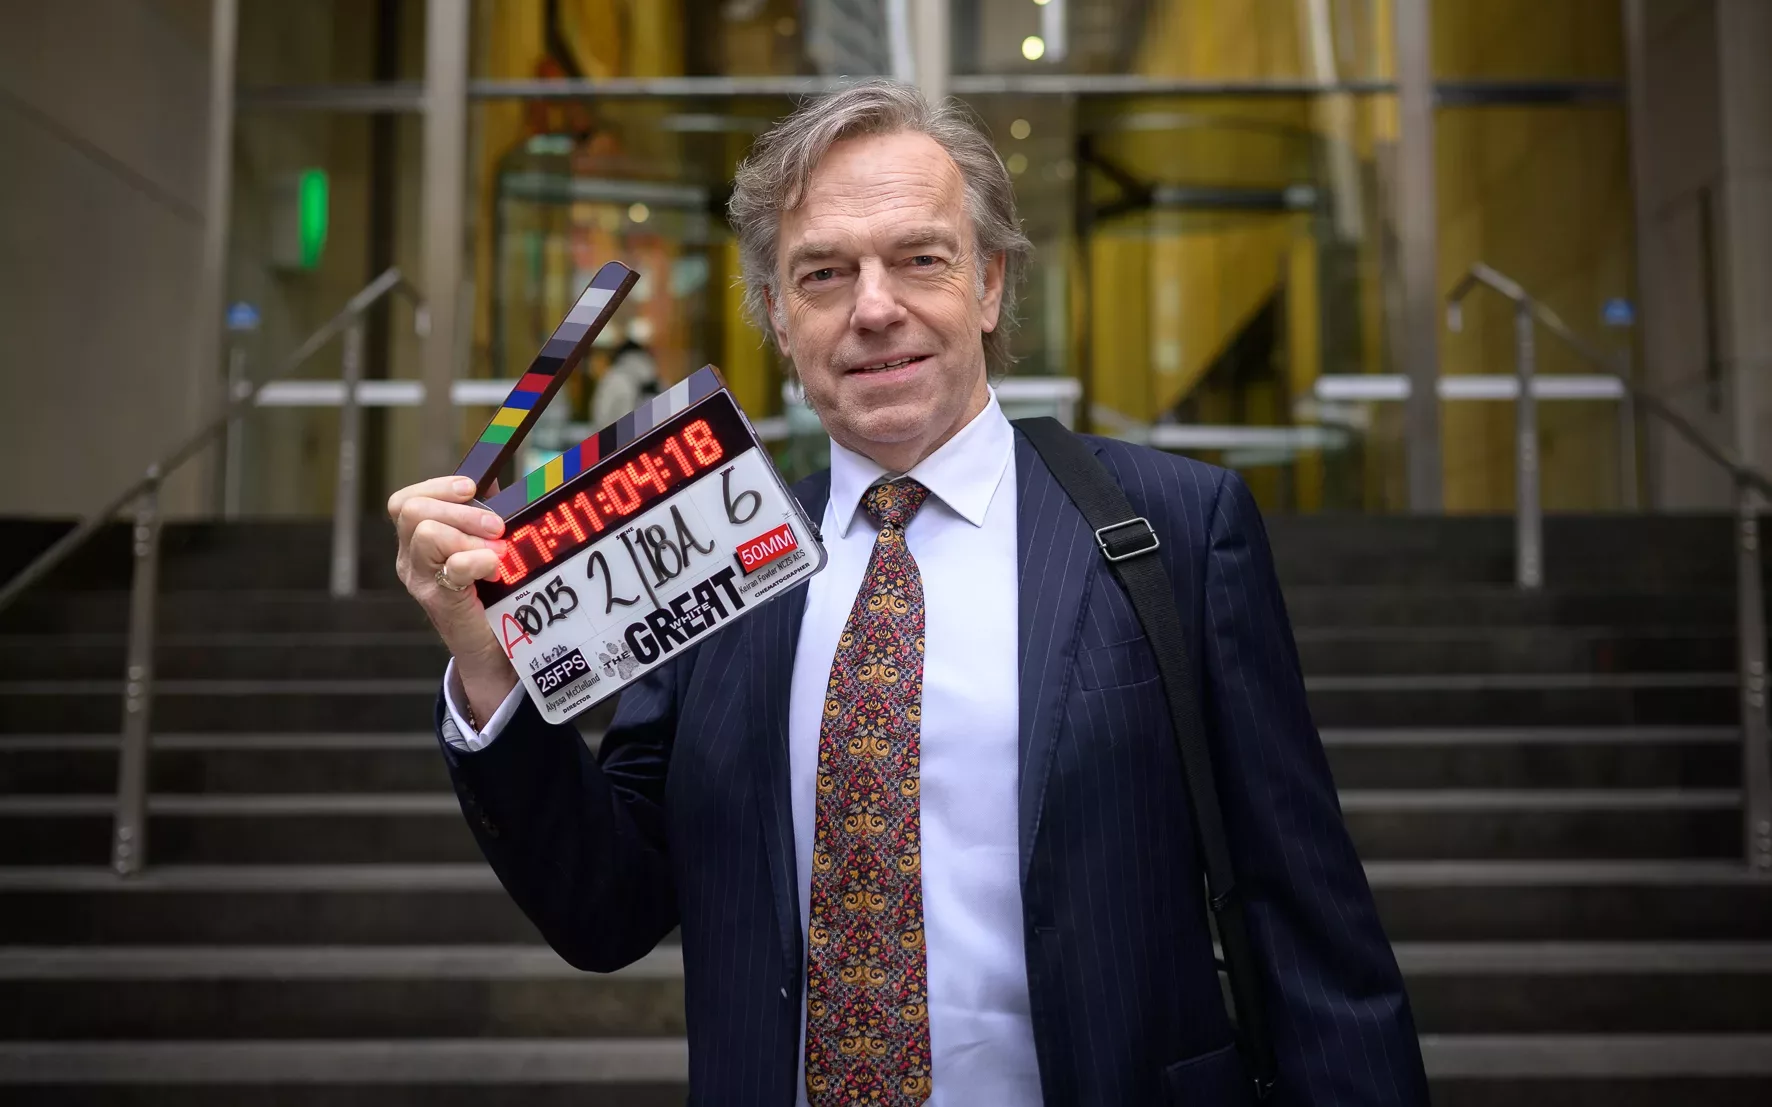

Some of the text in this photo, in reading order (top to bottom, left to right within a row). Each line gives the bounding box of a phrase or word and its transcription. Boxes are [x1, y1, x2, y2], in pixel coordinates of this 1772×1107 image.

[720, 465, 736, 477] TKE
[498, 419, 723, 585] 07:41:04:18
[722, 469, 762, 524] 6
[615, 526, 634, 540] SENE
[741, 530, 793, 565] 50MM
[739, 578, 758, 594] Keiran
[758, 567, 778, 583] Fowler
[793, 549, 806, 562] ACS
[754, 562, 810, 598] CINEMATOGRAPHER
[515, 590, 530, 601] ROLL
[603, 565, 745, 669] THE GREAT
[669, 602, 711, 630] WHITE
[536, 654, 586, 693] 25FPS
[545, 673, 600, 712] Alyssa McClelland
[562, 694, 591, 714] DIRECTOR
